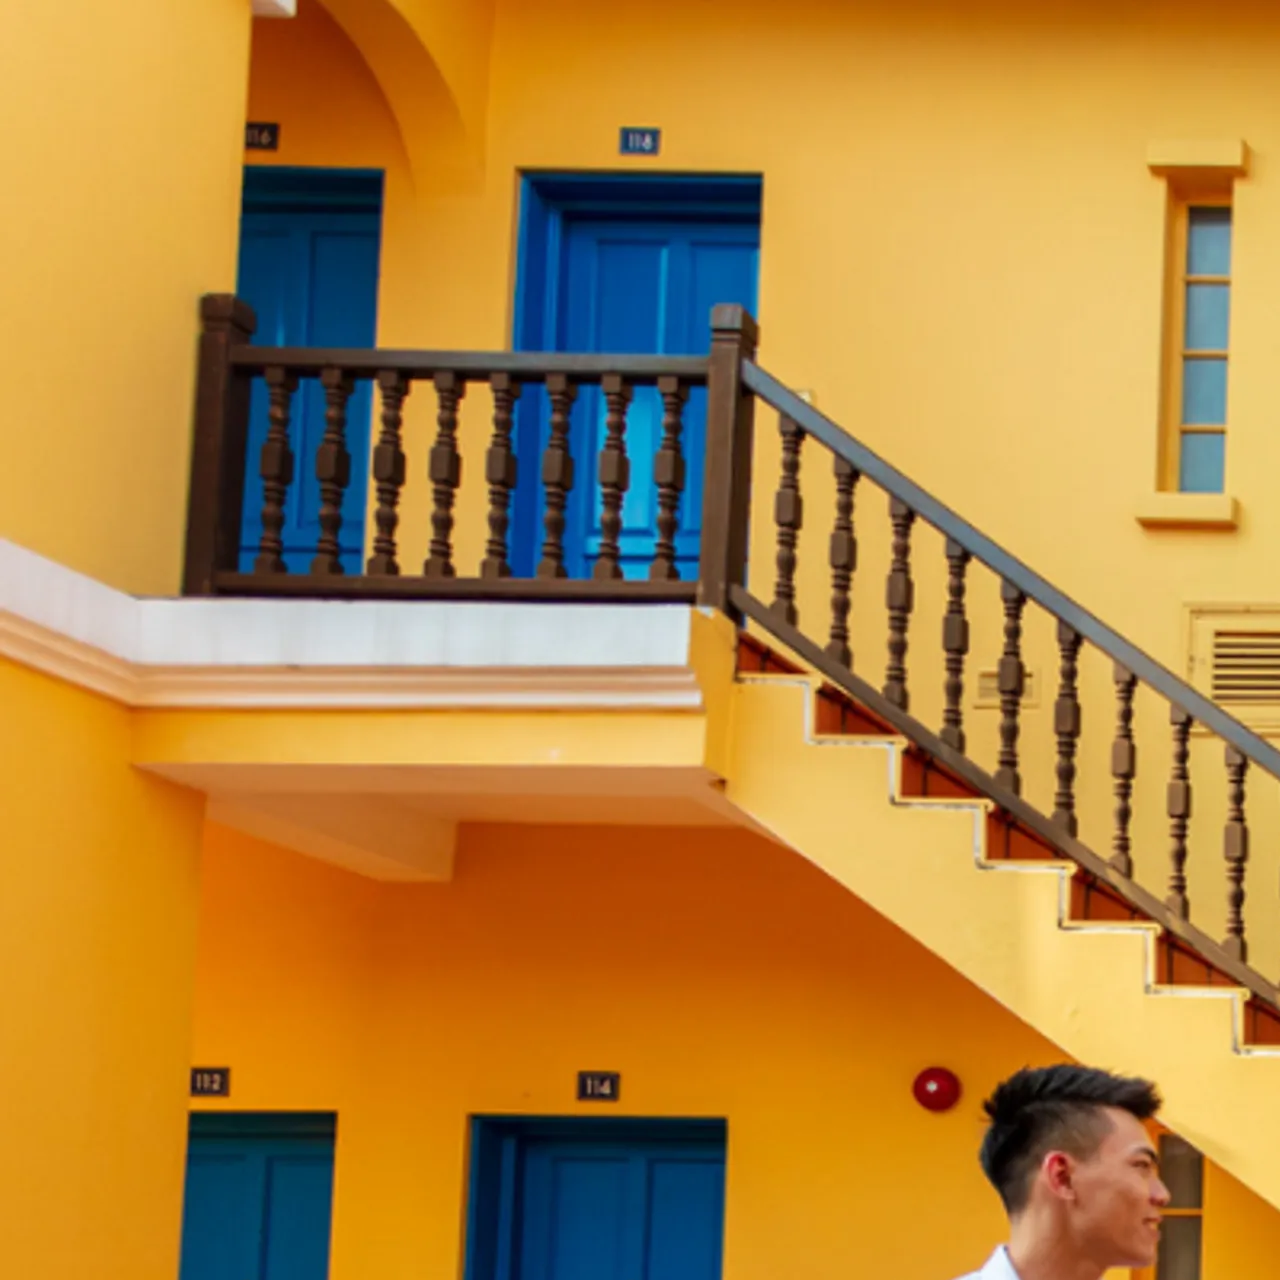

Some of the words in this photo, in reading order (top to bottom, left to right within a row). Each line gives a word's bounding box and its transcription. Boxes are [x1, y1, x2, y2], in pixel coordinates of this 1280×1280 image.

[628, 132, 653, 150] 118
[196, 1073, 221, 1090] 112
[586, 1077, 611, 1095] 114
